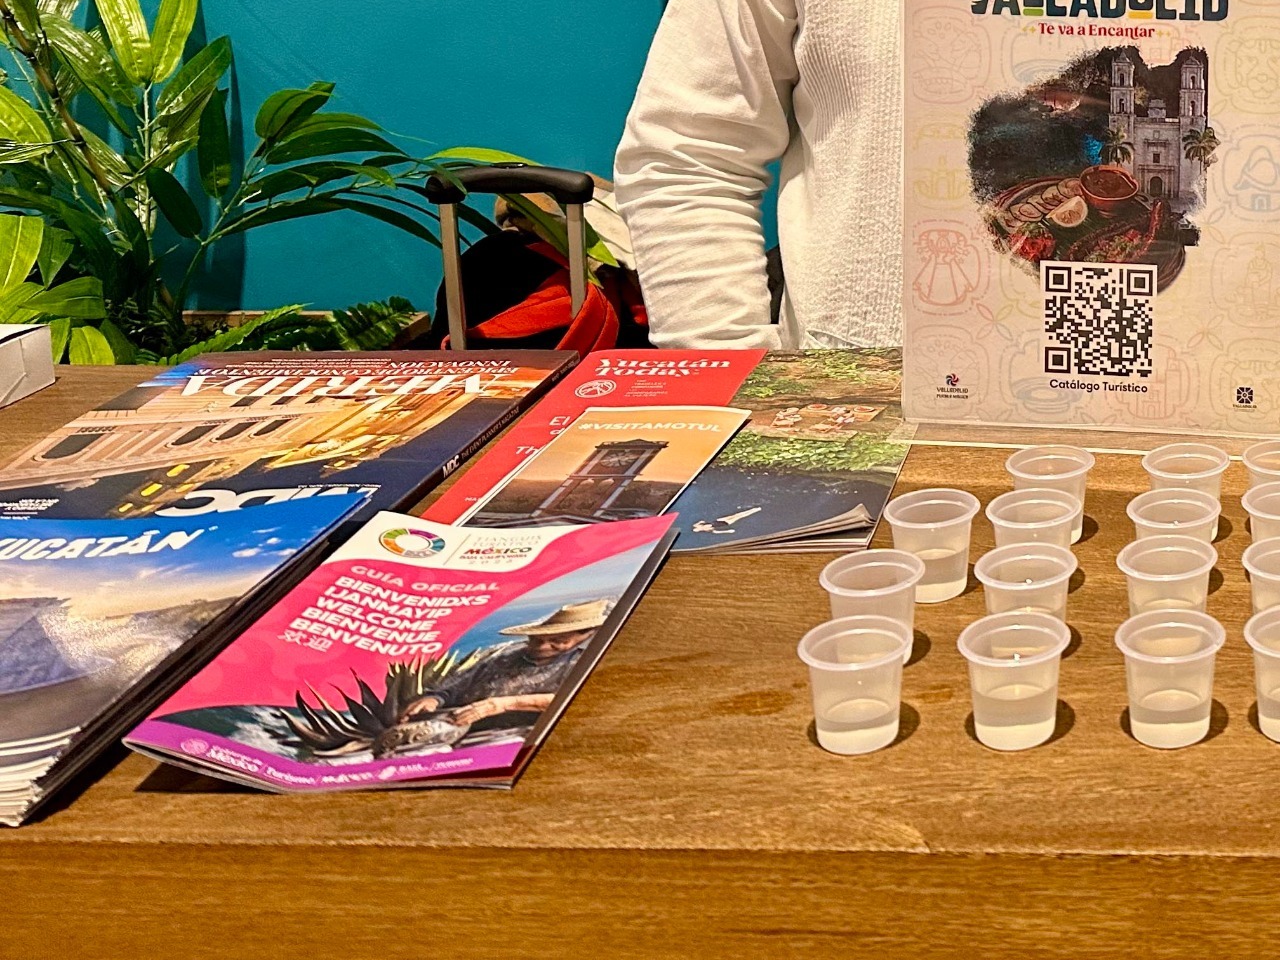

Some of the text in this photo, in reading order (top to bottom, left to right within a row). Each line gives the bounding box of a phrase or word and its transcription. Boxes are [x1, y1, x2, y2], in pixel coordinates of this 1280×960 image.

[1038, 23, 1155, 39] Te va a Encantar
[595, 367, 692, 378] Today
[598, 357, 730, 368] Yucatán
[1049, 378, 1148, 393] Catálogo Turístico
[578, 422, 722, 432] #VISITAMOTUL
[442, 454, 460, 477] MDC
[350, 565, 501, 593] GUÍA OFICIAL
[324, 587, 453, 619] IJANMAYIP
[334, 576, 491, 608] BIENVENIDXS
[301, 607, 441, 643] BIENVENUE
[316, 596, 437, 631] WELCOME
[289, 617, 443, 657] BENVENUTO
